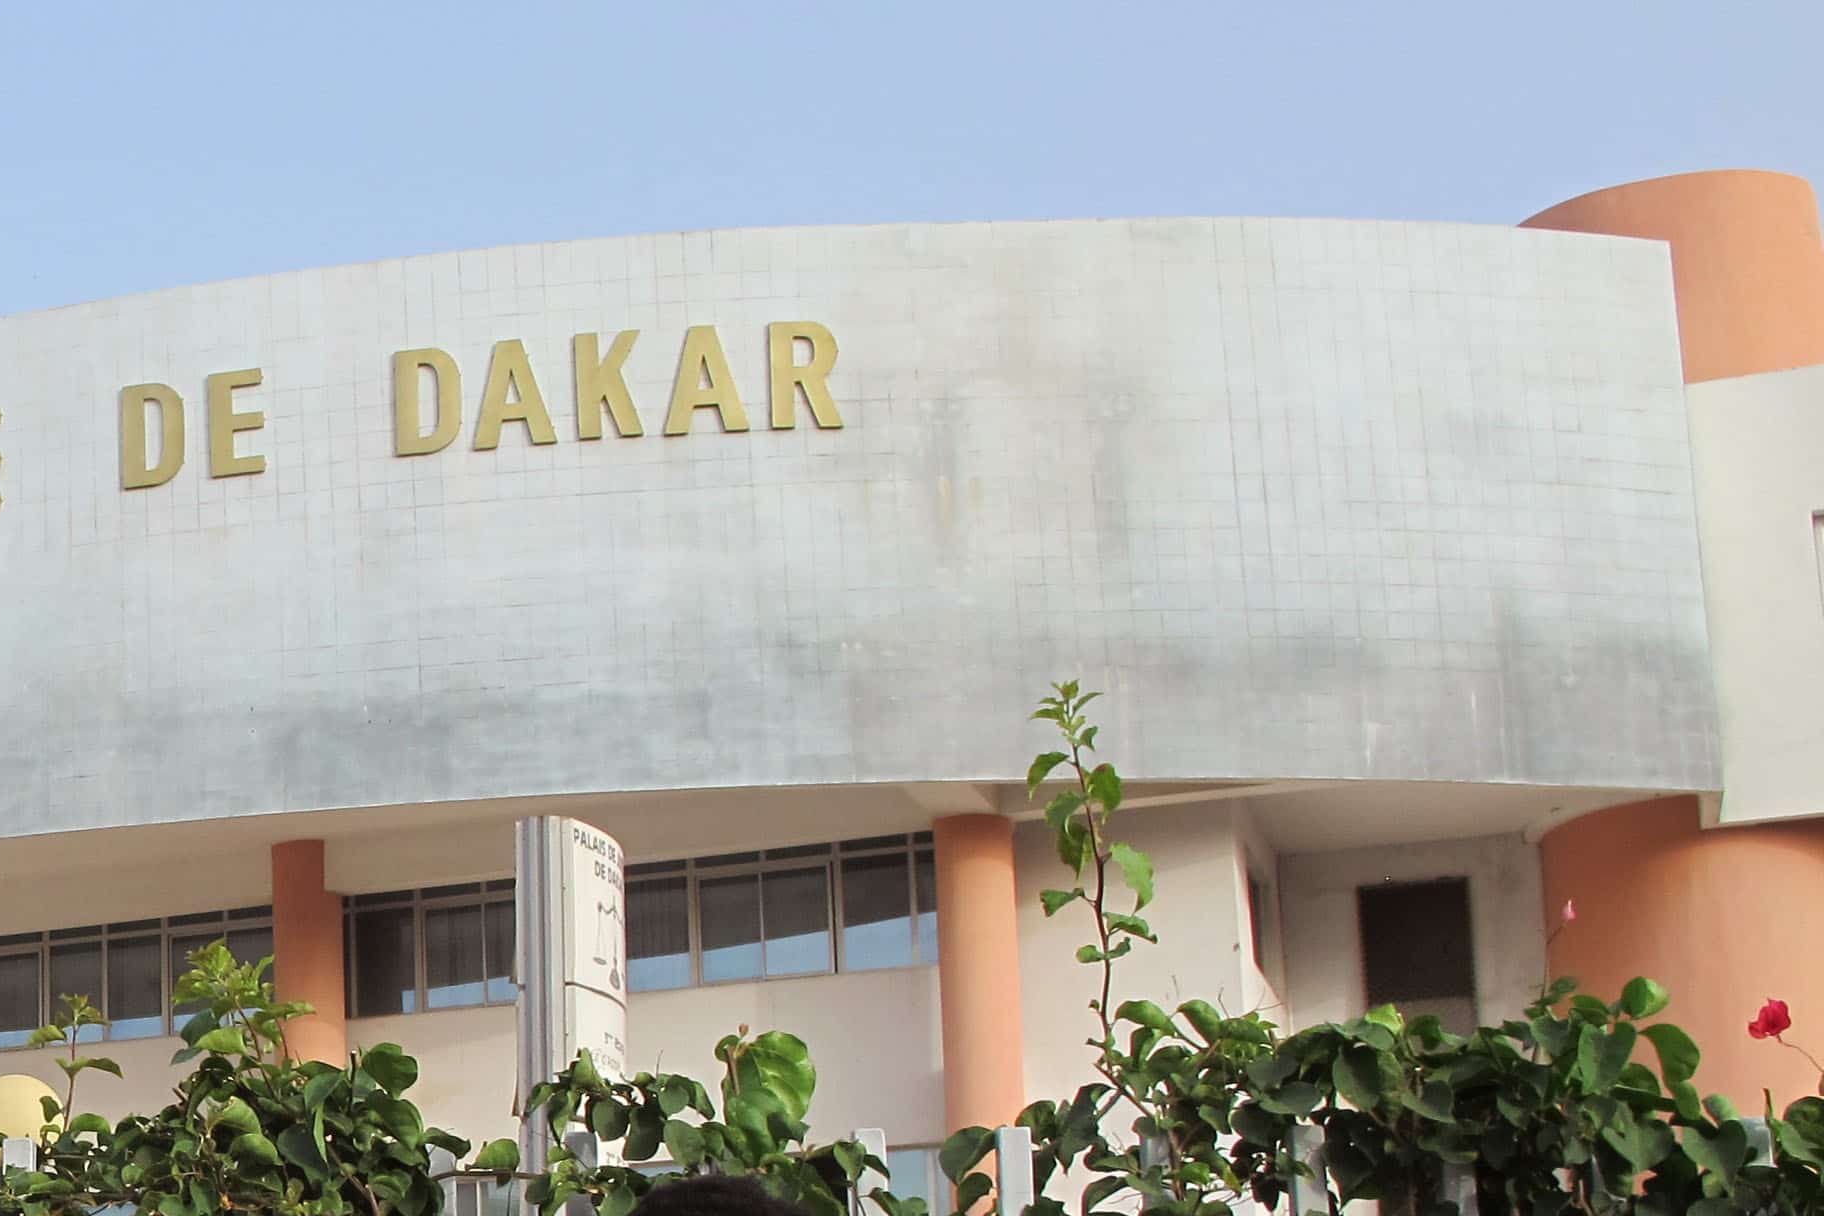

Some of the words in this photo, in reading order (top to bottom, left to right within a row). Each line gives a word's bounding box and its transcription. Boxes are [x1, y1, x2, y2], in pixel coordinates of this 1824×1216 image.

[122, 367, 268, 491] DE
[393, 320, 845, 459] DAKAR
[573, 827, 606, 857] PALAIS
[594, 860, 606, 880] DE
